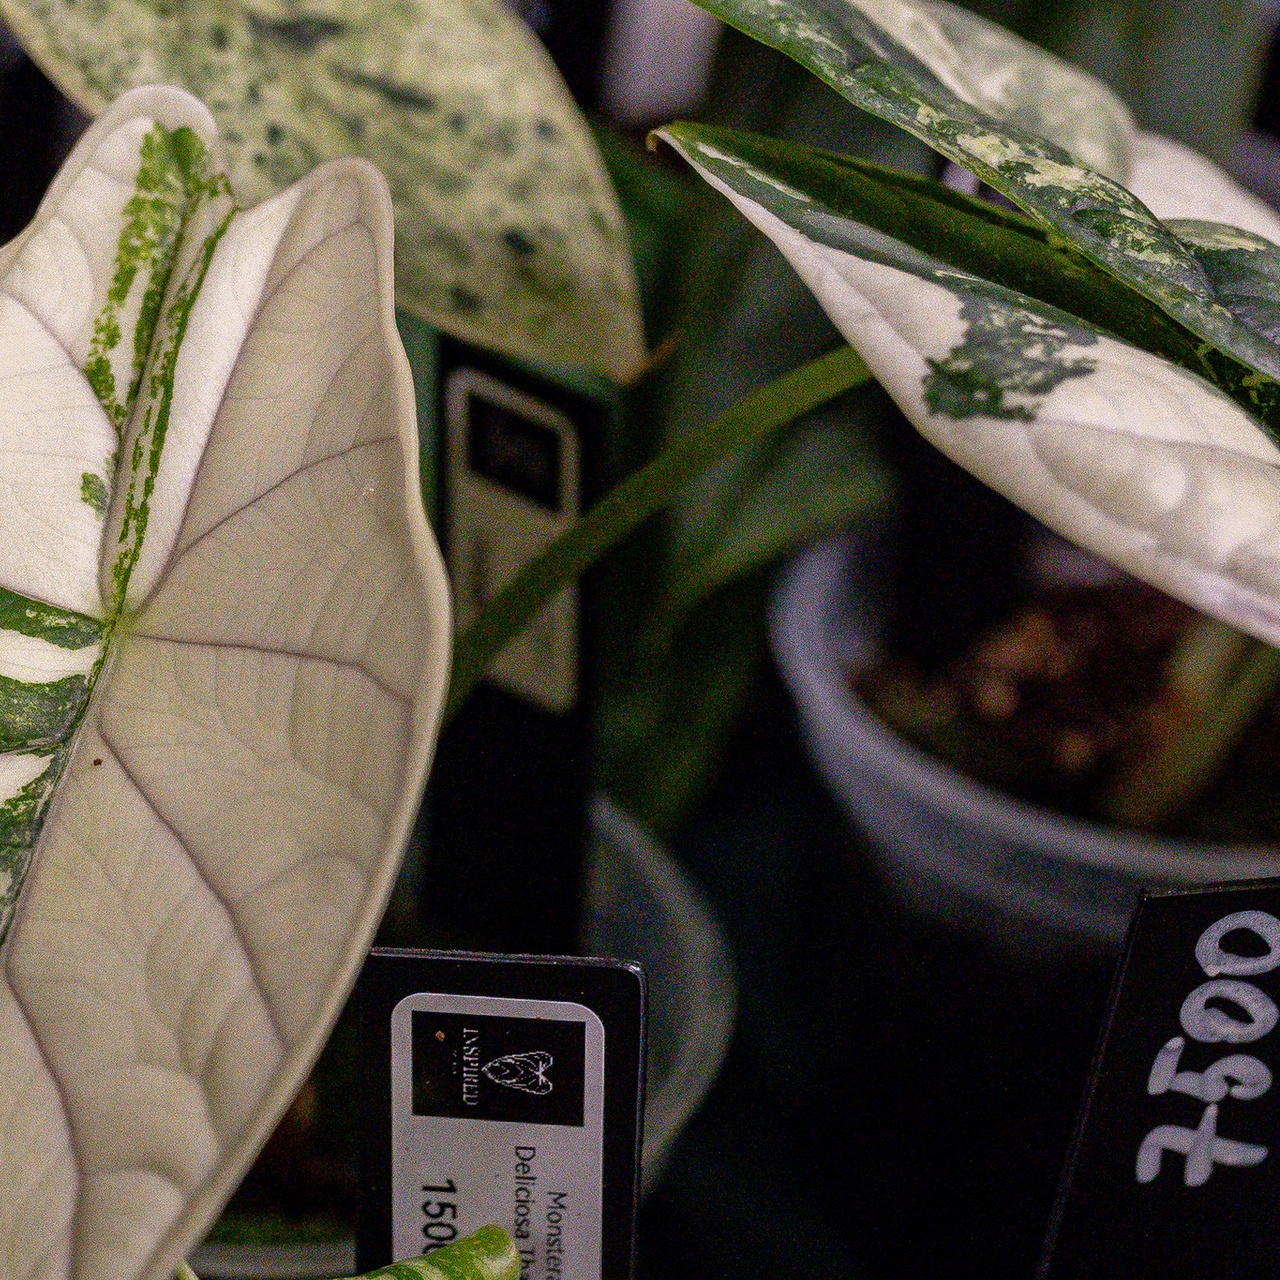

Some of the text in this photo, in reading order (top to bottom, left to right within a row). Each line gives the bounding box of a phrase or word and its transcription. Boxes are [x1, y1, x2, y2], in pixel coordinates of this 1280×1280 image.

[461, 1027, 479, 1106] INSPIRED
[1135, 909, 1280, 1187] 7500
[514, 1145, 536, 1240] Deliciosa
